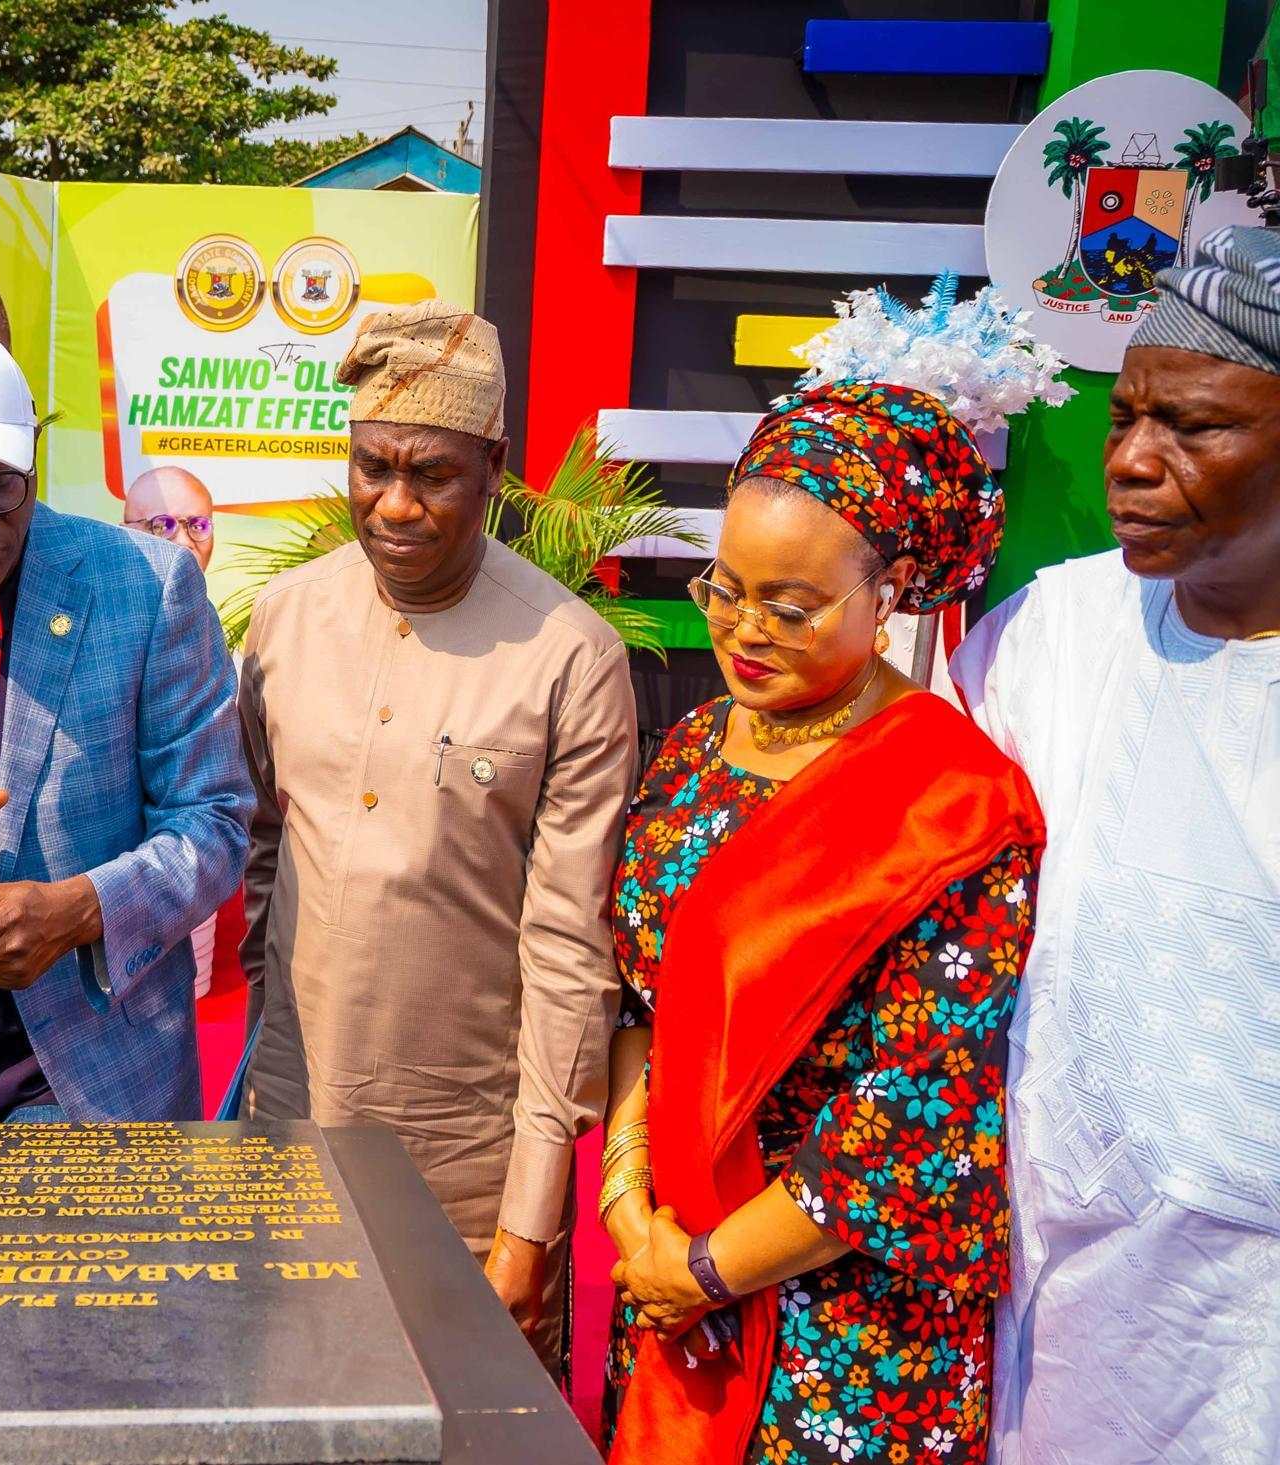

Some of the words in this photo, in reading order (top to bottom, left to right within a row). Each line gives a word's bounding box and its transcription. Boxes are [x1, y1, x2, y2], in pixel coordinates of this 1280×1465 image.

[1043, 299, 1090, 312] JUSTICE
[1108, 313, 1133, 322] AND
[258, 343, 316, 371] The
[158, 356, 271, 391] SANWO
[128, 394, 254, 428] HAMZAT
[255, 397, 351, 431] EFFEC
[158, 436, 349, 455] #GREATERLAGOSRISIN
[7, 1148, 99, 1156] NIGERIA
[64, 1155, 140, 1163] (PHASE
[289, 1163, 318, 1171] BY
[62, 1173, 170, 1182] (SECTION
[262, 1171, 321, 1179] NAVY
[35, 1184, 182, 1194] CRANEBURG
[194, 1183, 284, 1192] MESSRS
[295, 1182, 325, 1191] BY
[73, 1195, 144, 1203] (BUBA
[157, 1194, 218, 1202] ADIO
[228, 1192, 333, 1201] MUMUNI
[57, 1206, 183, 1216] FOUNTAIN
[198, 1205, 295, 1213] MESSRS
[307, 1204, 337, 1212] BY
[179, 1216, 253, 1225] ROAD
[264, 1215, 342, 1224] IREDE
[271, 1229, 304, 1240] IN
[264, 1261, 359, 1281] MR.
[75, 1293, 156, 1307] THIS
